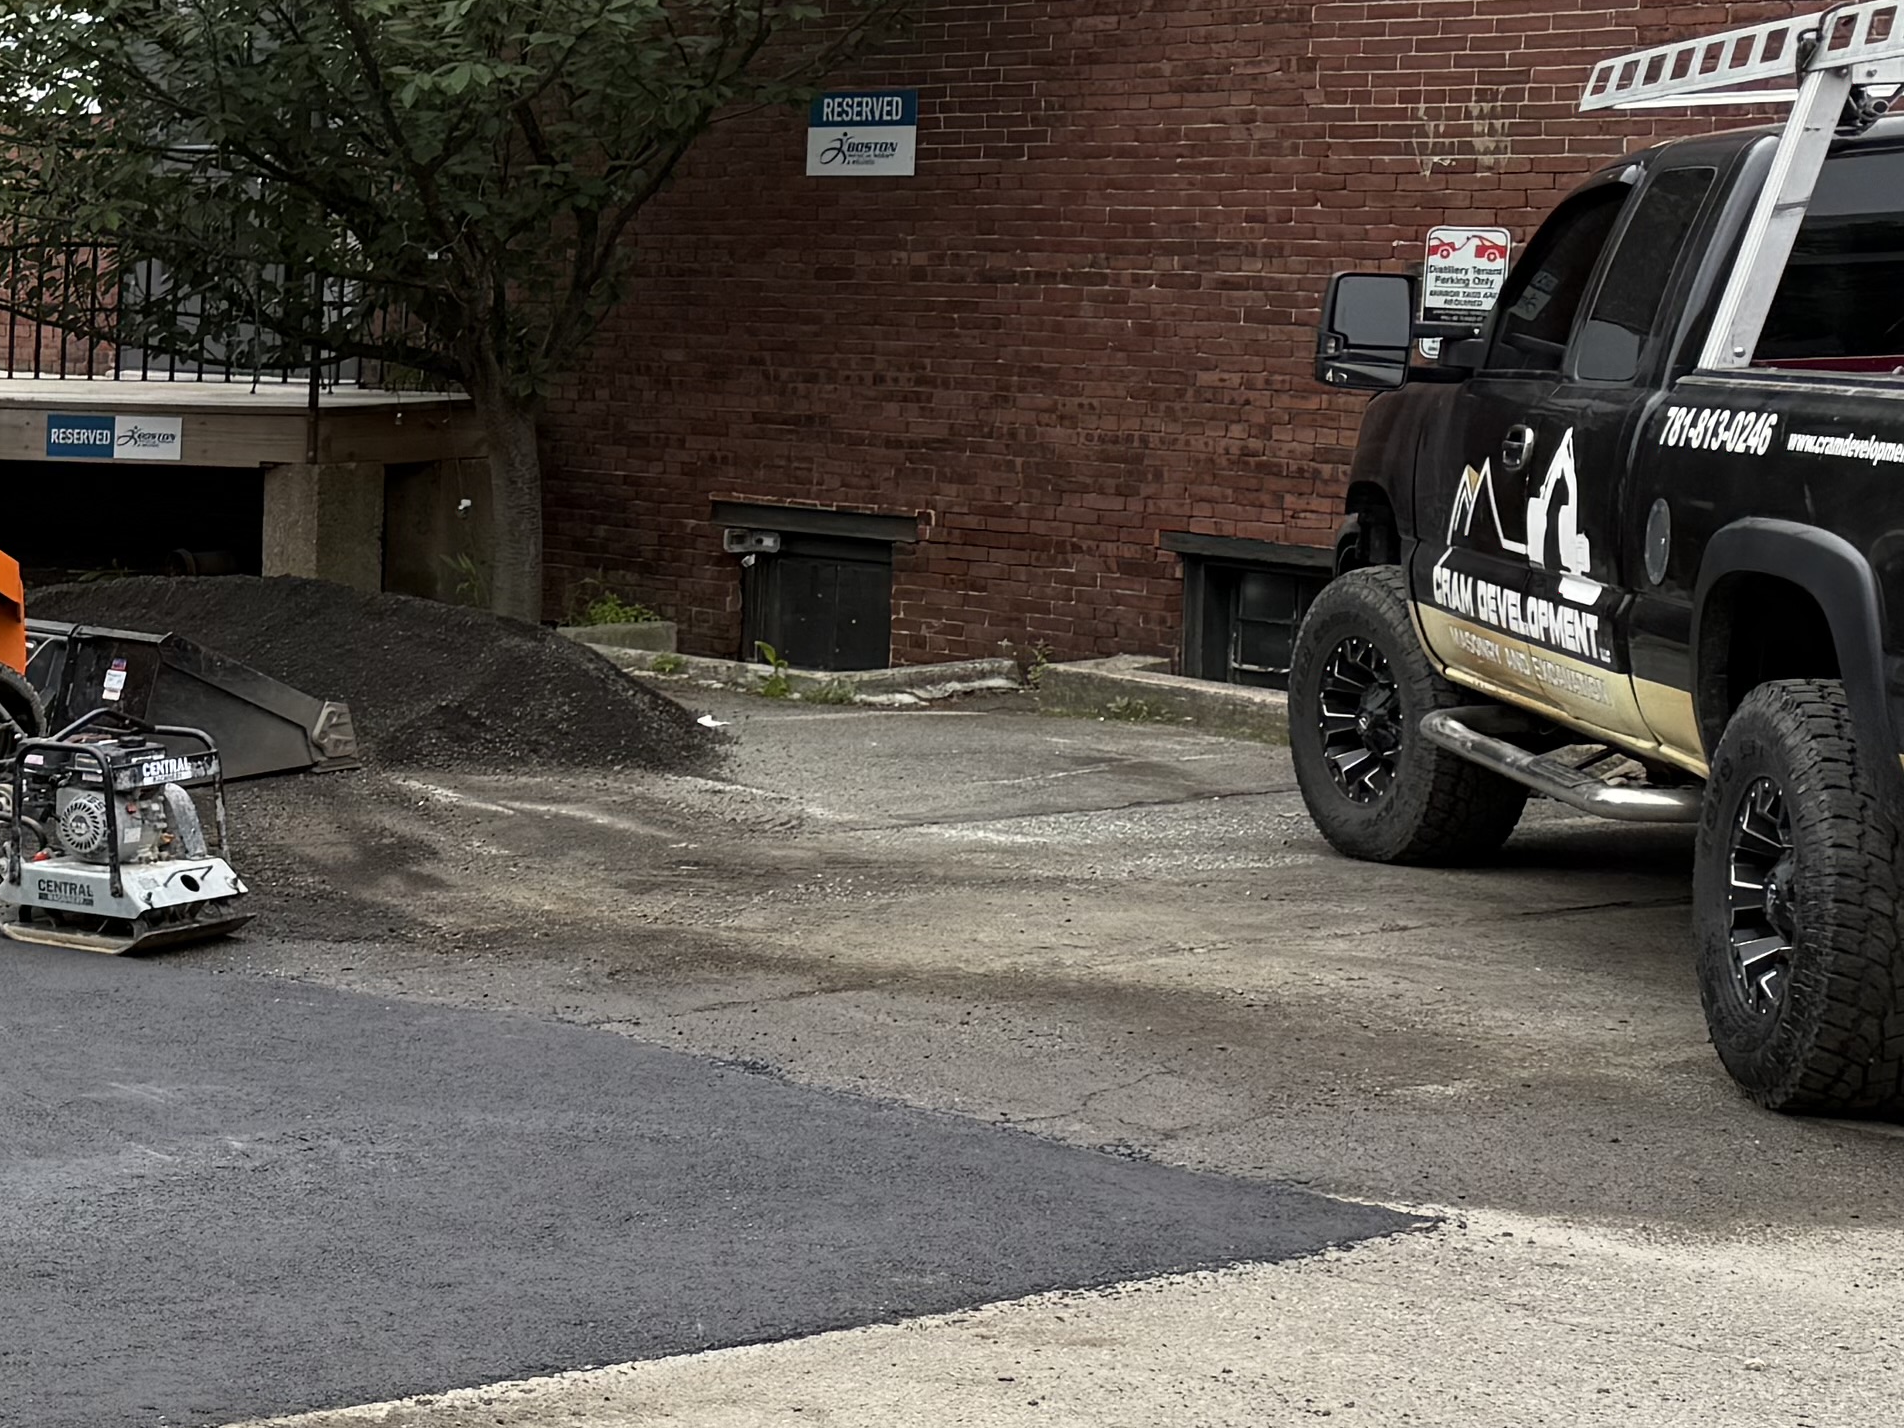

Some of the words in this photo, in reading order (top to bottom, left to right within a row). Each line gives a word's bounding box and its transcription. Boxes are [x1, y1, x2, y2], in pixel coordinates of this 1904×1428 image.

[823, 96, 903, 122] RESERVED
[1435, 275, 1470, 287] Parking
[1473, 276, 1495, 288] Only
[51, 428, 111, 445] RESERVED
[1659, 406, 1778, 456] 781-813-0246
[1787, 432, 1904, 467] www.cramdevelopme
[1433, 565, 1474, 617] CRAM
[1477, 580, 1599, 659] DEVELOPMENT
[142, 756, 192, 777] CENTRAL
[38, 878, 94, 898] CENTRAL
